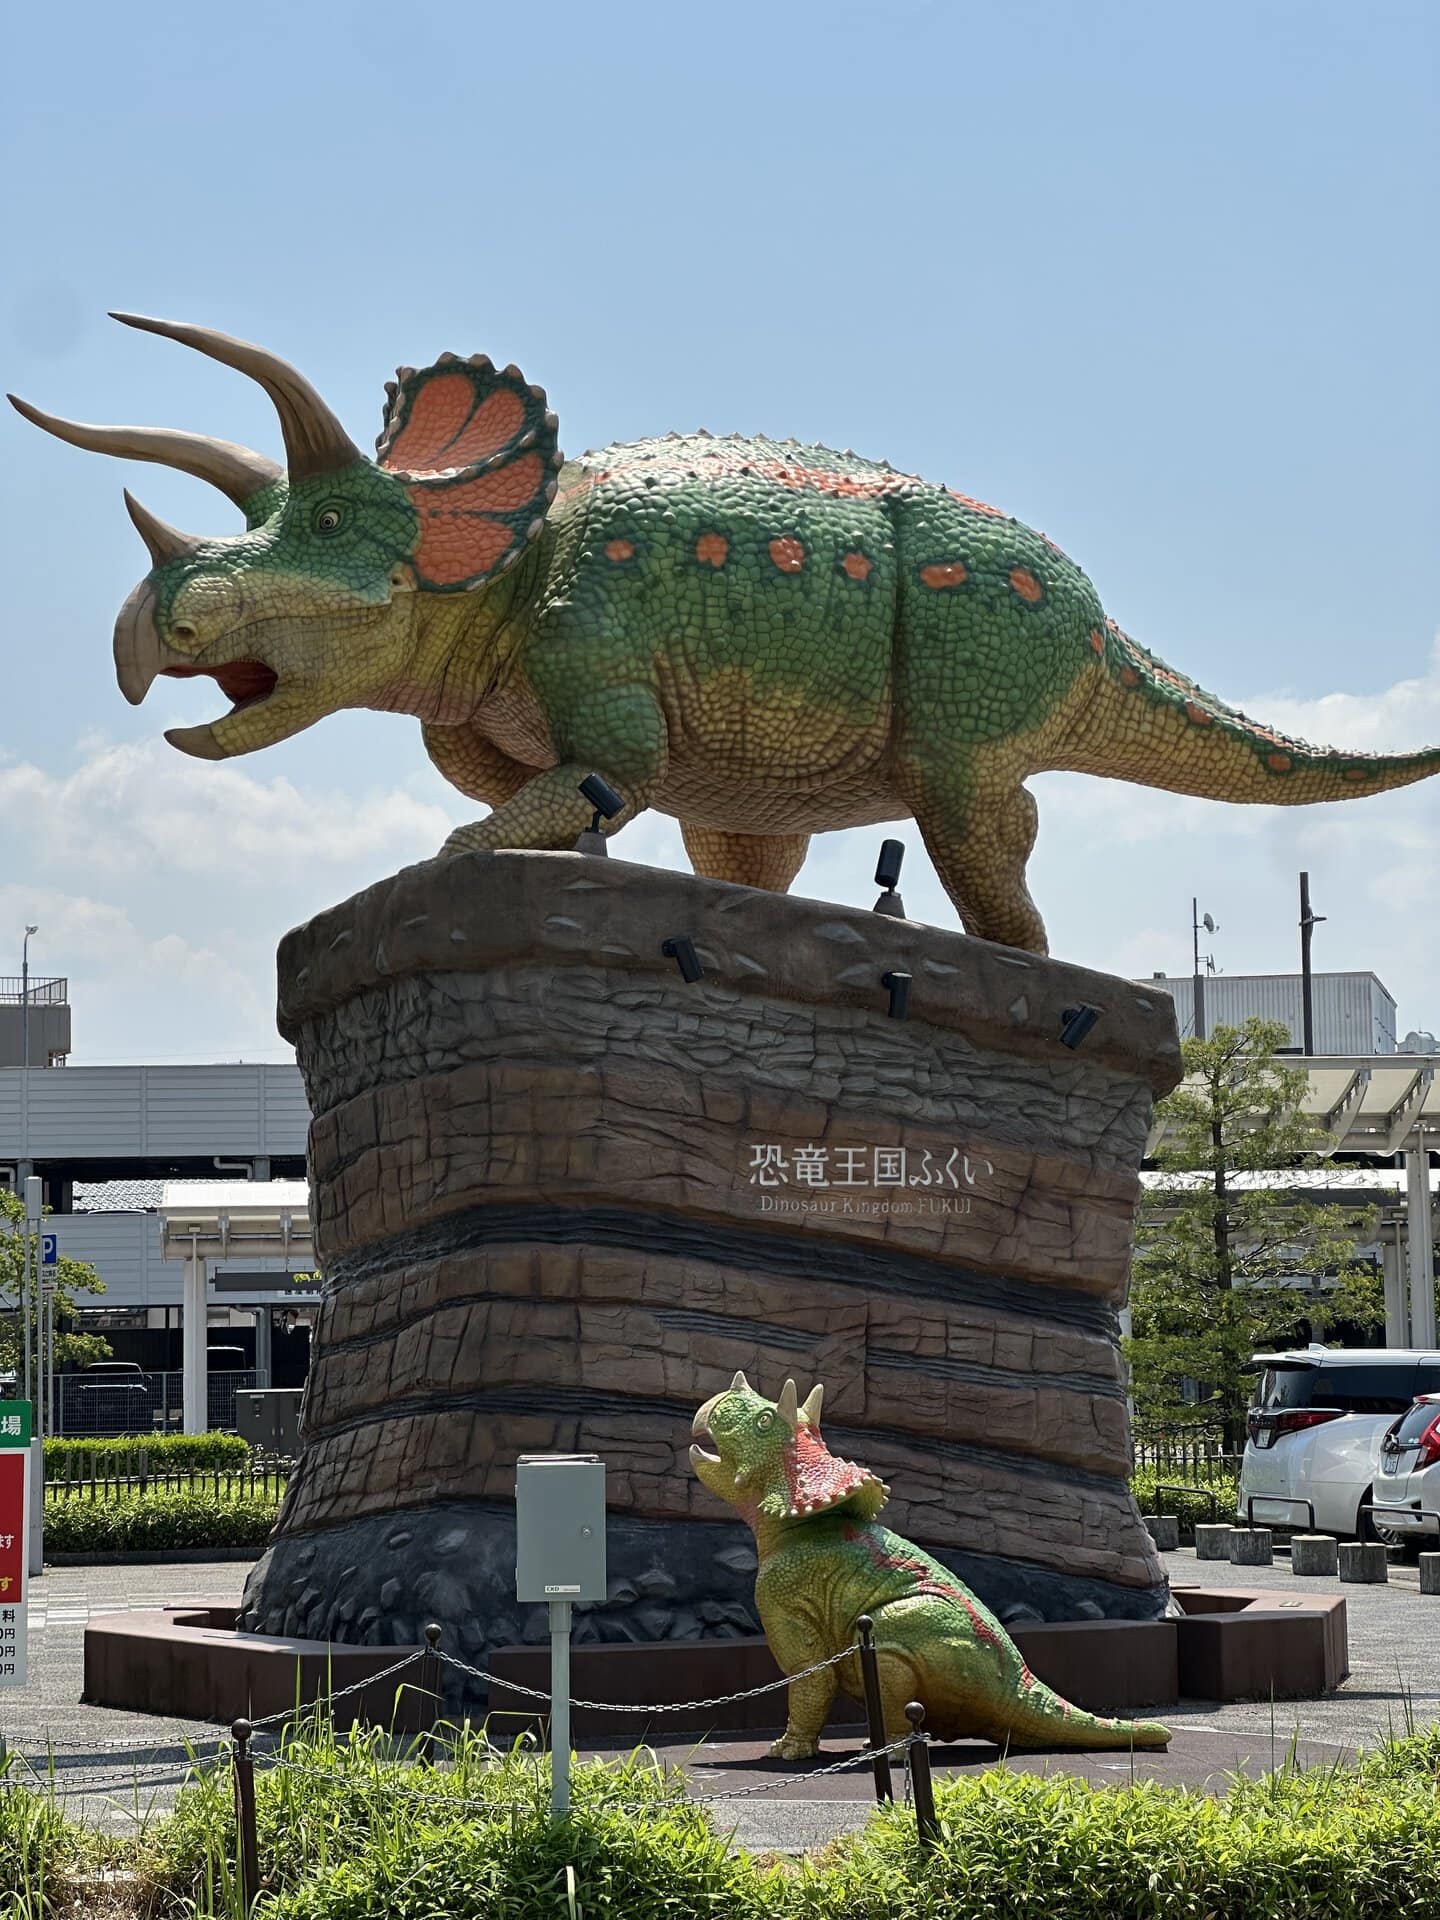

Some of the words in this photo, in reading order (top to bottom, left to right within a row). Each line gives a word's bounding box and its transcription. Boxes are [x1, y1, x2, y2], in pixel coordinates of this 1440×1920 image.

[749, 1143, 995, 1189] 恐竜王国ふくい
[760, 1195, 837, 1213] Dinosaur
[842, 1197, 913, 1216] Kingdom
[918, 1197, 972, 1215] FUKUI
[43, 1237, 54, 1262] P
[0, 1415, 22, 1436] 場
[2, 1608, 16, 1623] 料
